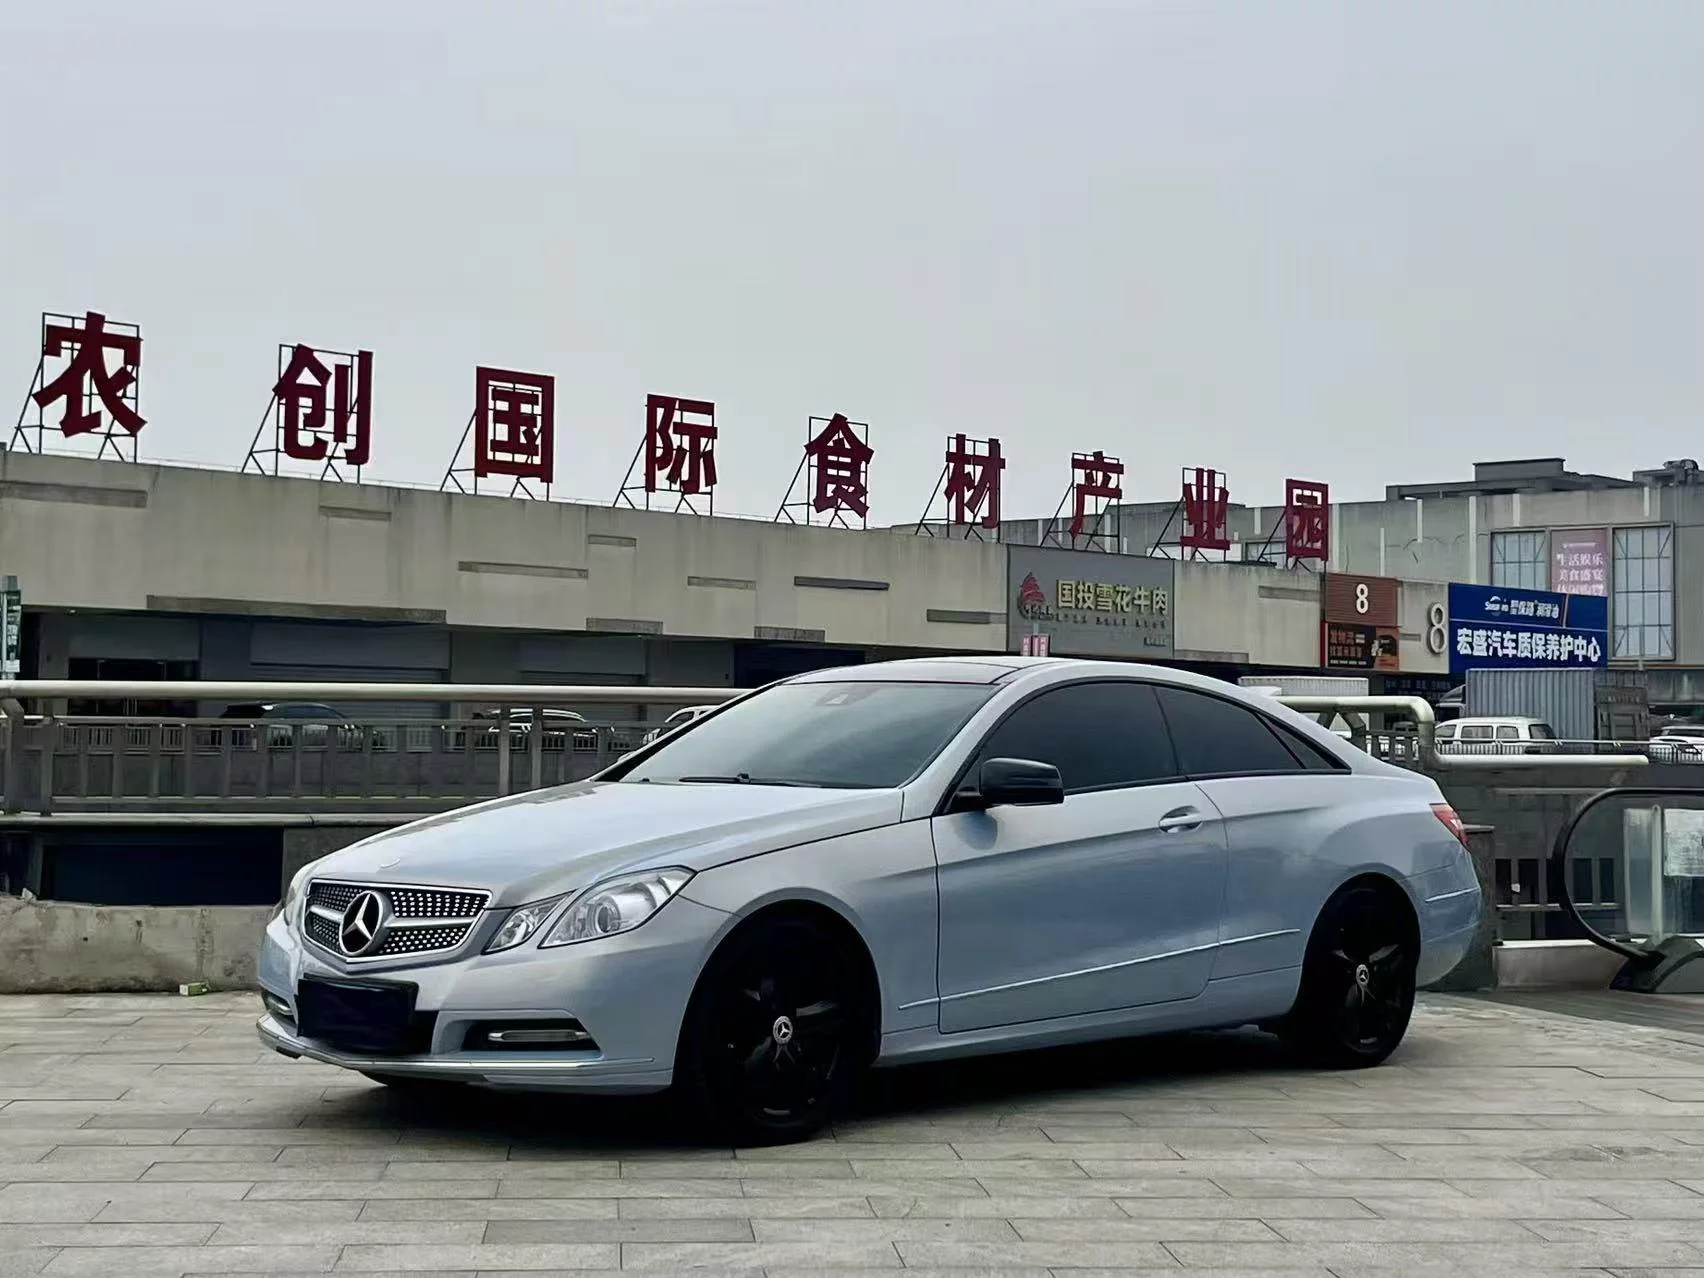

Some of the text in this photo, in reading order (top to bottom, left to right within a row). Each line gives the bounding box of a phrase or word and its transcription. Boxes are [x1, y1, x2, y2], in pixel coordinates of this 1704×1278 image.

[33, 312, 1328, 560] 农创国际食材产业园
[1057, 579, 1168, 615] 国投雪花牛肉
[1356, 584, 1369, 614] 8
[1429, 602, 1447, 654] 8
[1457, 628, 1601, 663] 宏盛汽车质保养护中心
